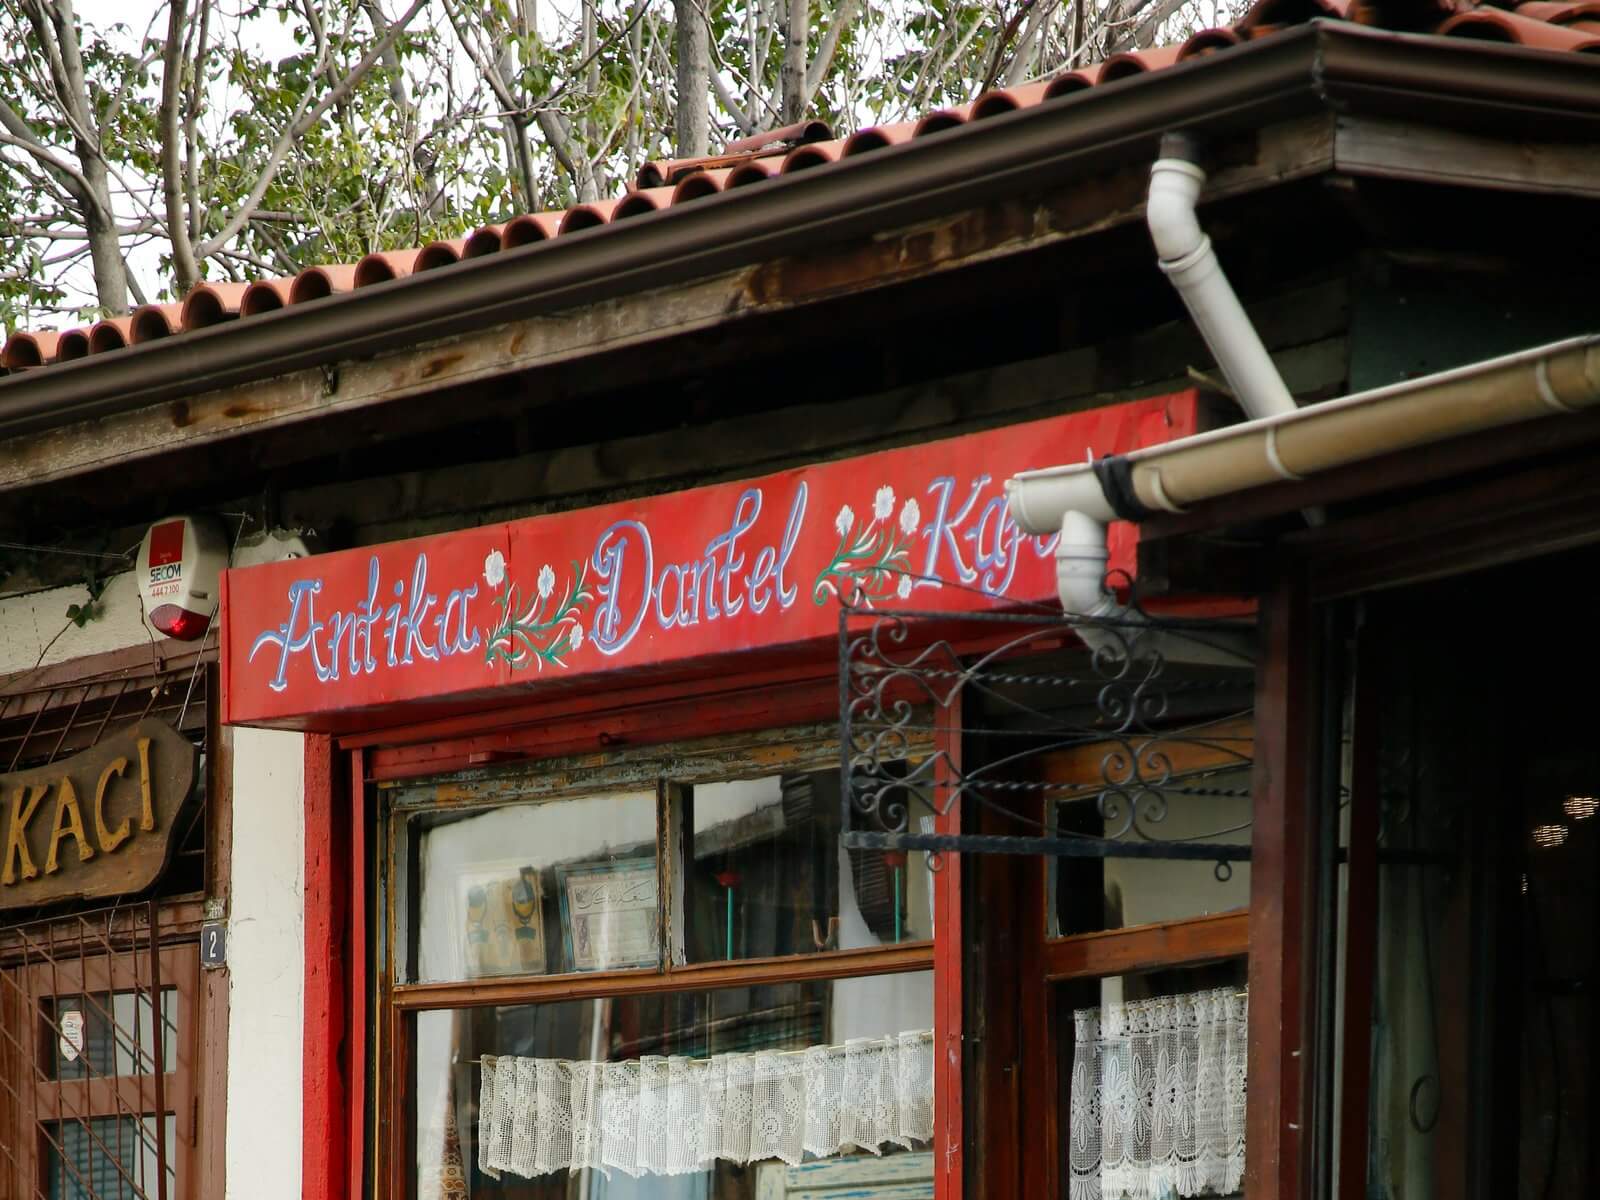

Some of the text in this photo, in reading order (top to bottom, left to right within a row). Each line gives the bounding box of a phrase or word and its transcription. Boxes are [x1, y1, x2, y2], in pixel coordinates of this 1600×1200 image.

[150, 563, 181, 583] SECOM
[248, 553, 481, 693] Antika
[588, 480, 808, 656] Dantel
[209, 930, 217, 958] 2
